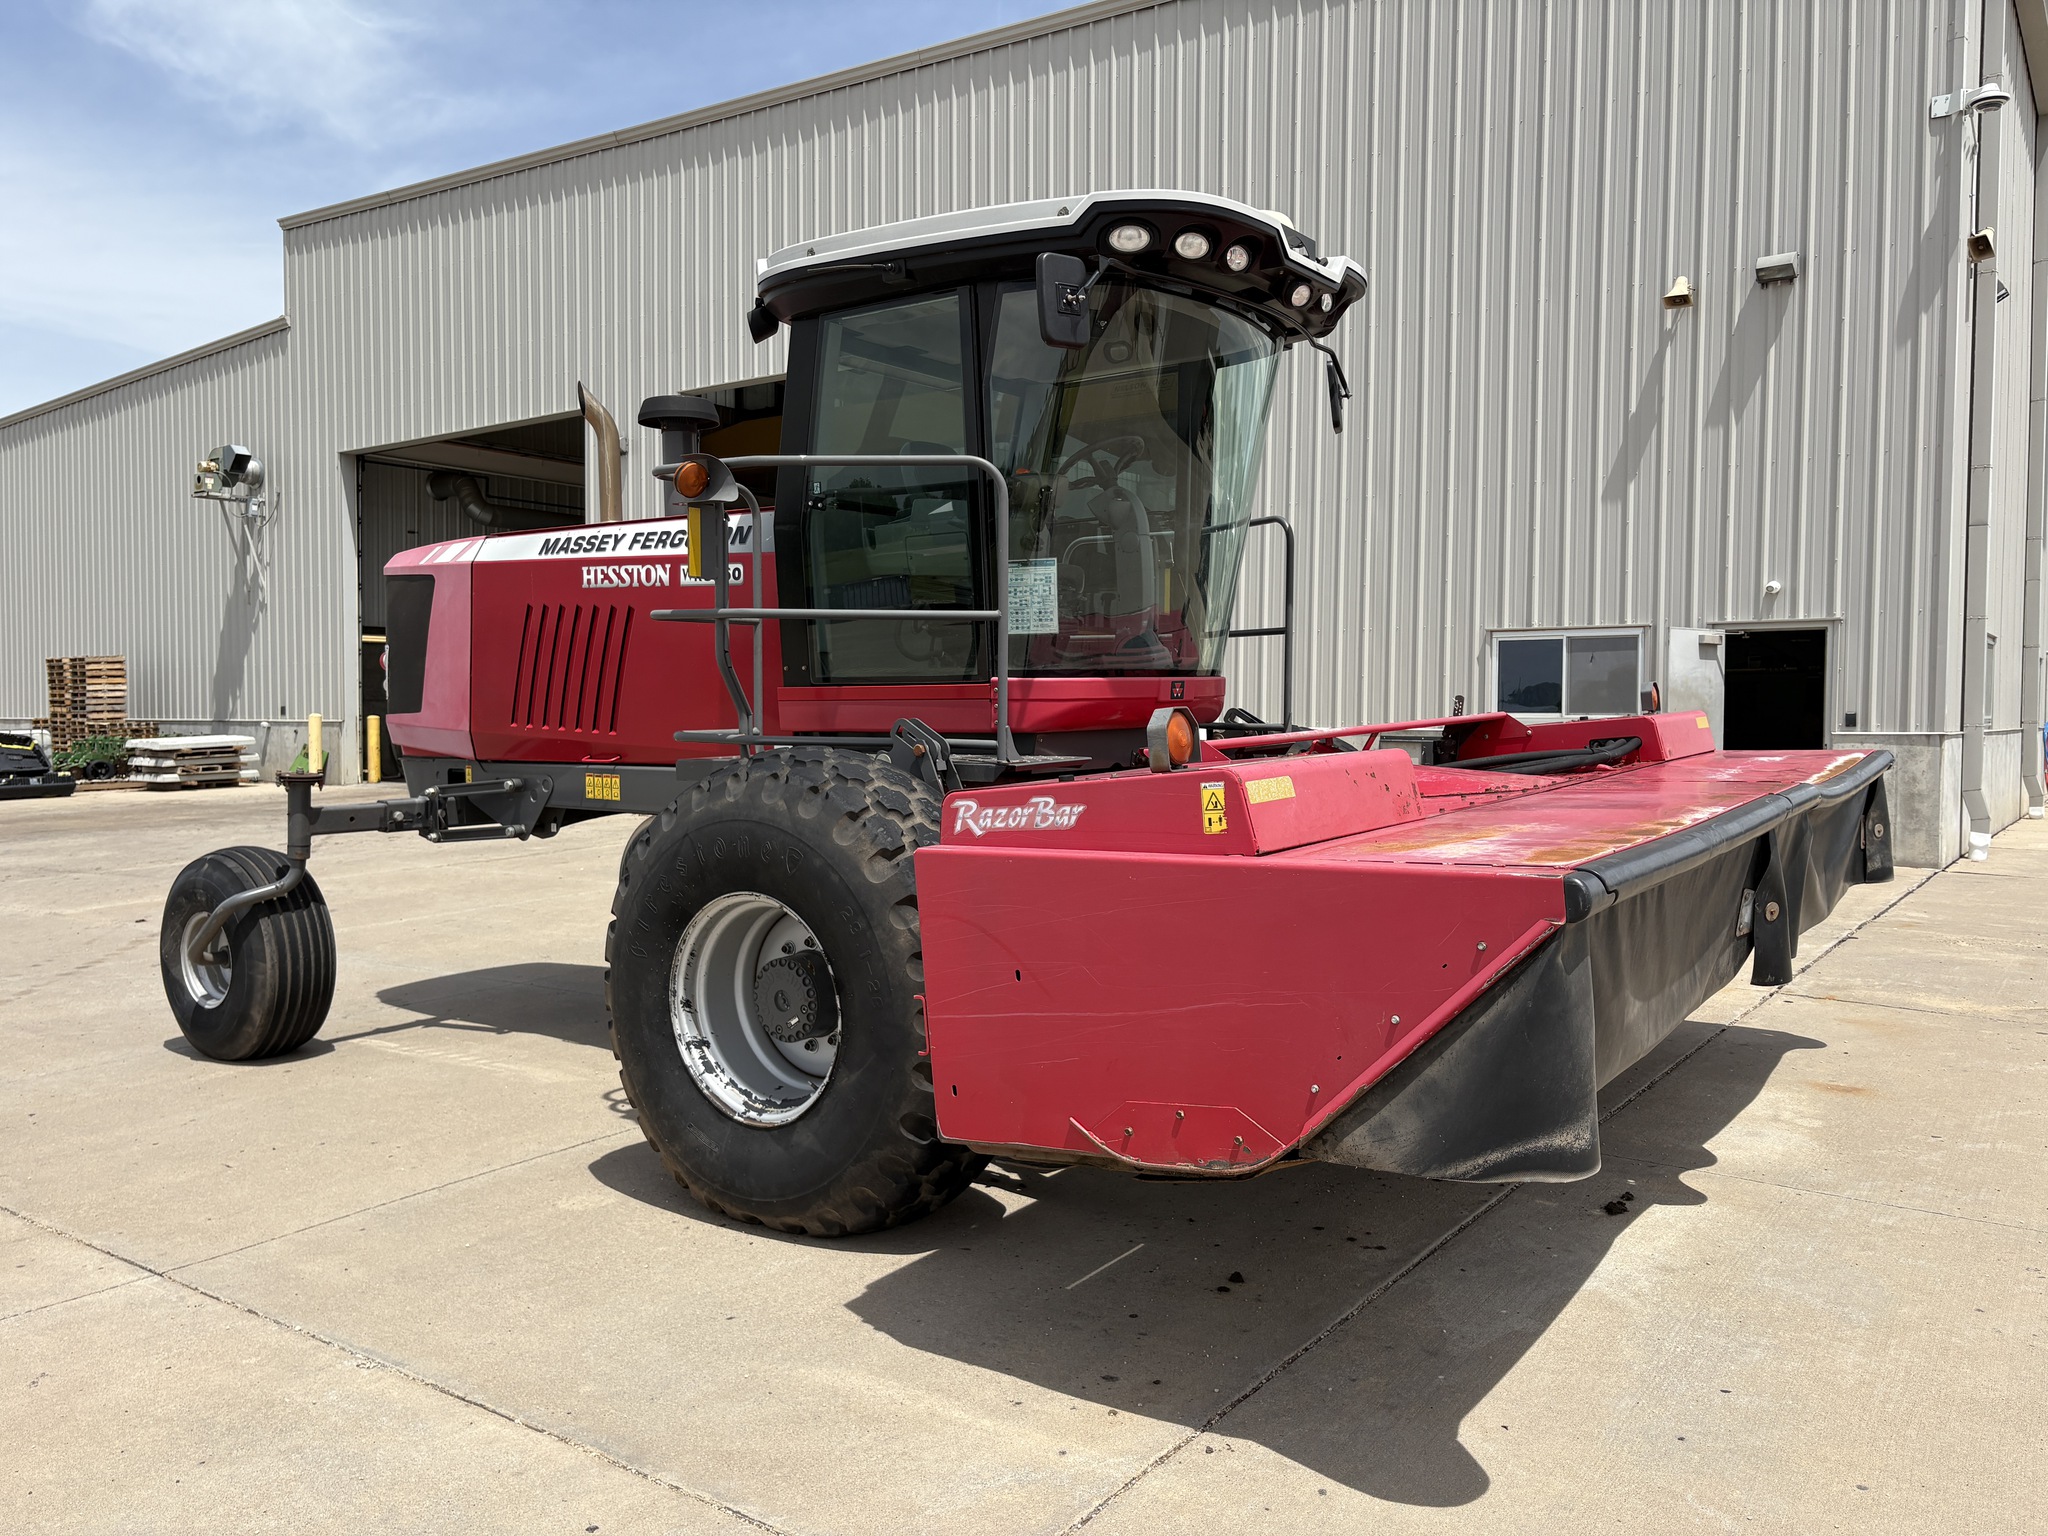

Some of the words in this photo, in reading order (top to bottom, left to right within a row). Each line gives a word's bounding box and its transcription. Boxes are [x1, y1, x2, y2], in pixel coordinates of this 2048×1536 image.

[538, 533, 627, 556] MASSEY
[628, 526, 752, 551] FERGN
[582, 564, 671, 588] HESSTON
